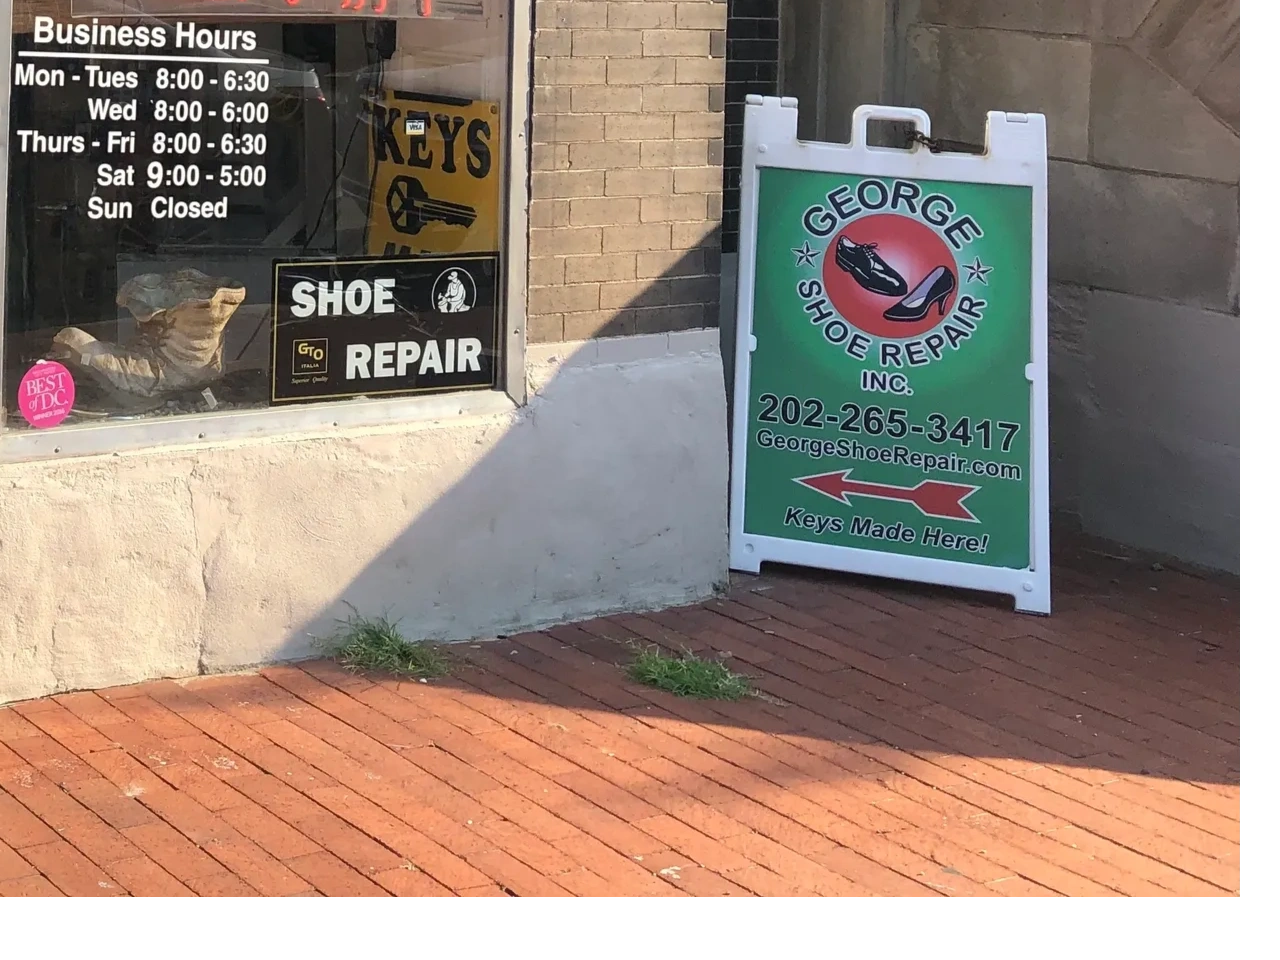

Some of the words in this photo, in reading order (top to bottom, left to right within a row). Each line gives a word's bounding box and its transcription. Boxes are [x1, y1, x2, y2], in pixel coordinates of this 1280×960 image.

[33, 16, 166, 48] Business
[176, 22, 257, 51] Hours
[14, 63, 65, 86] Mon
[85, 65, 139, 89] Tues
[156, 68, 203, 90] 8:00
[223, 70, 269, 92] 6:30
[88, 98, 137, 121] Wed
[153, 100, 202, 122] 8:00
[222, 101, 269, 123] 6:00
[17, 130, 85, 153] Thurs
[107, 131, 136, 153] Fri
[152, 132, 201, 154] 8:00
[221, 133, 267, 155] 6:30
[373, 106, 492, 179] KEYS
[97, 164, 135, 187] Sat
[147, 161, 200, 189] 9:00
[219, 165, 267, 187] 5:00
[87, 196, 133, 219] Sun
[150, 196, 228, 218] Closed
[801, 178, 985, 250] GEORGE
[290, 278, 396, 318] SHOE
[797, 278, 872, 361] SHOE
[880, 292, 988, 368] REPAIR
[298, 343, 324, 360] GTO
[345, 337, 482, 380] REPAIR
[26, 372, 67, 396] BEST
[861, 370, 914, 396] INC.
[29, 394, 39, 412] of
[757, 393, 1020, 452] 202-265-3417
[756, 429, 1022, 480] GeorgeShoeRepair.com
[784, 506, 843, 534] Keys
[850, 516, 916, 545] Made
[921, 526, 990, 555] Here!
